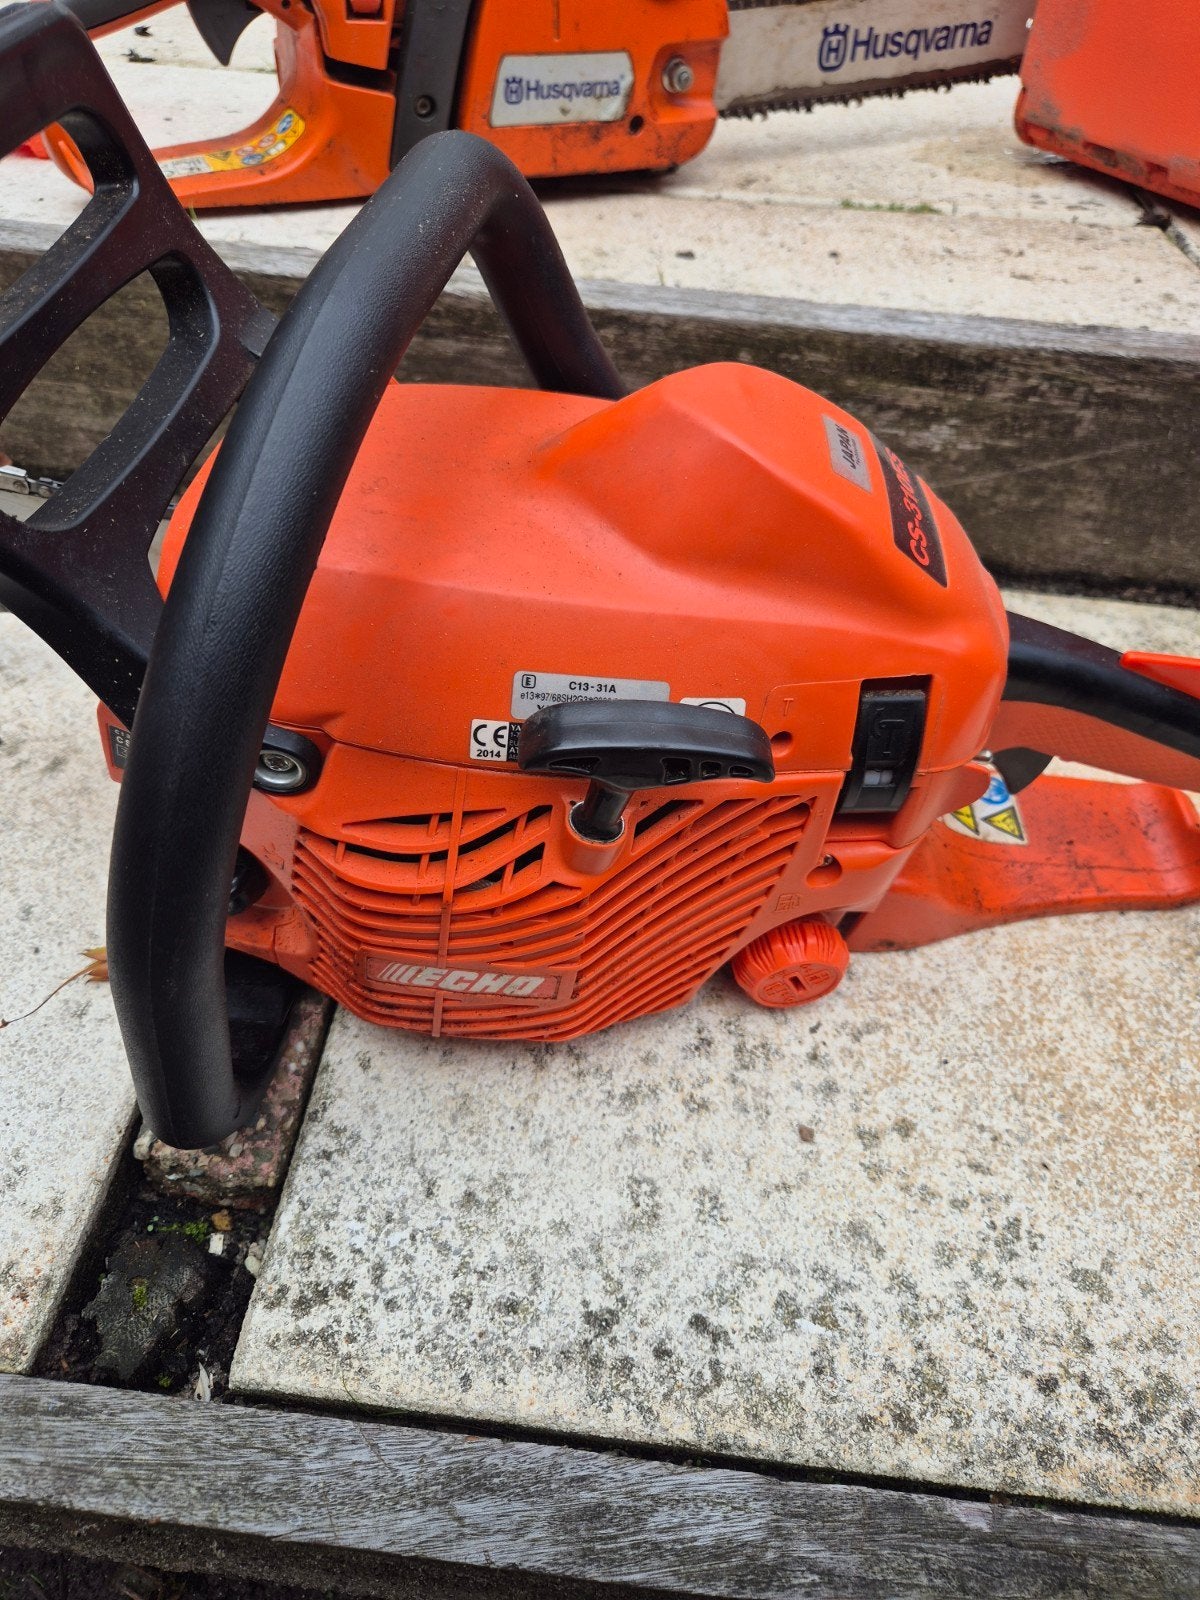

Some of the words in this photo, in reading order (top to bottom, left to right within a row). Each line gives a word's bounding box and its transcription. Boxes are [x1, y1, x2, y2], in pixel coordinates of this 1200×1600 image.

[850, 20, 993, 61] Husqvarna
[525, 79, 621, 102] Husqvarna
[835, 424, 857, 470] JAPAN
[473, 723, 508, 749] CE
[476, 749, 502, 759] 2014
[413, 966, 545, 997] ECHO
